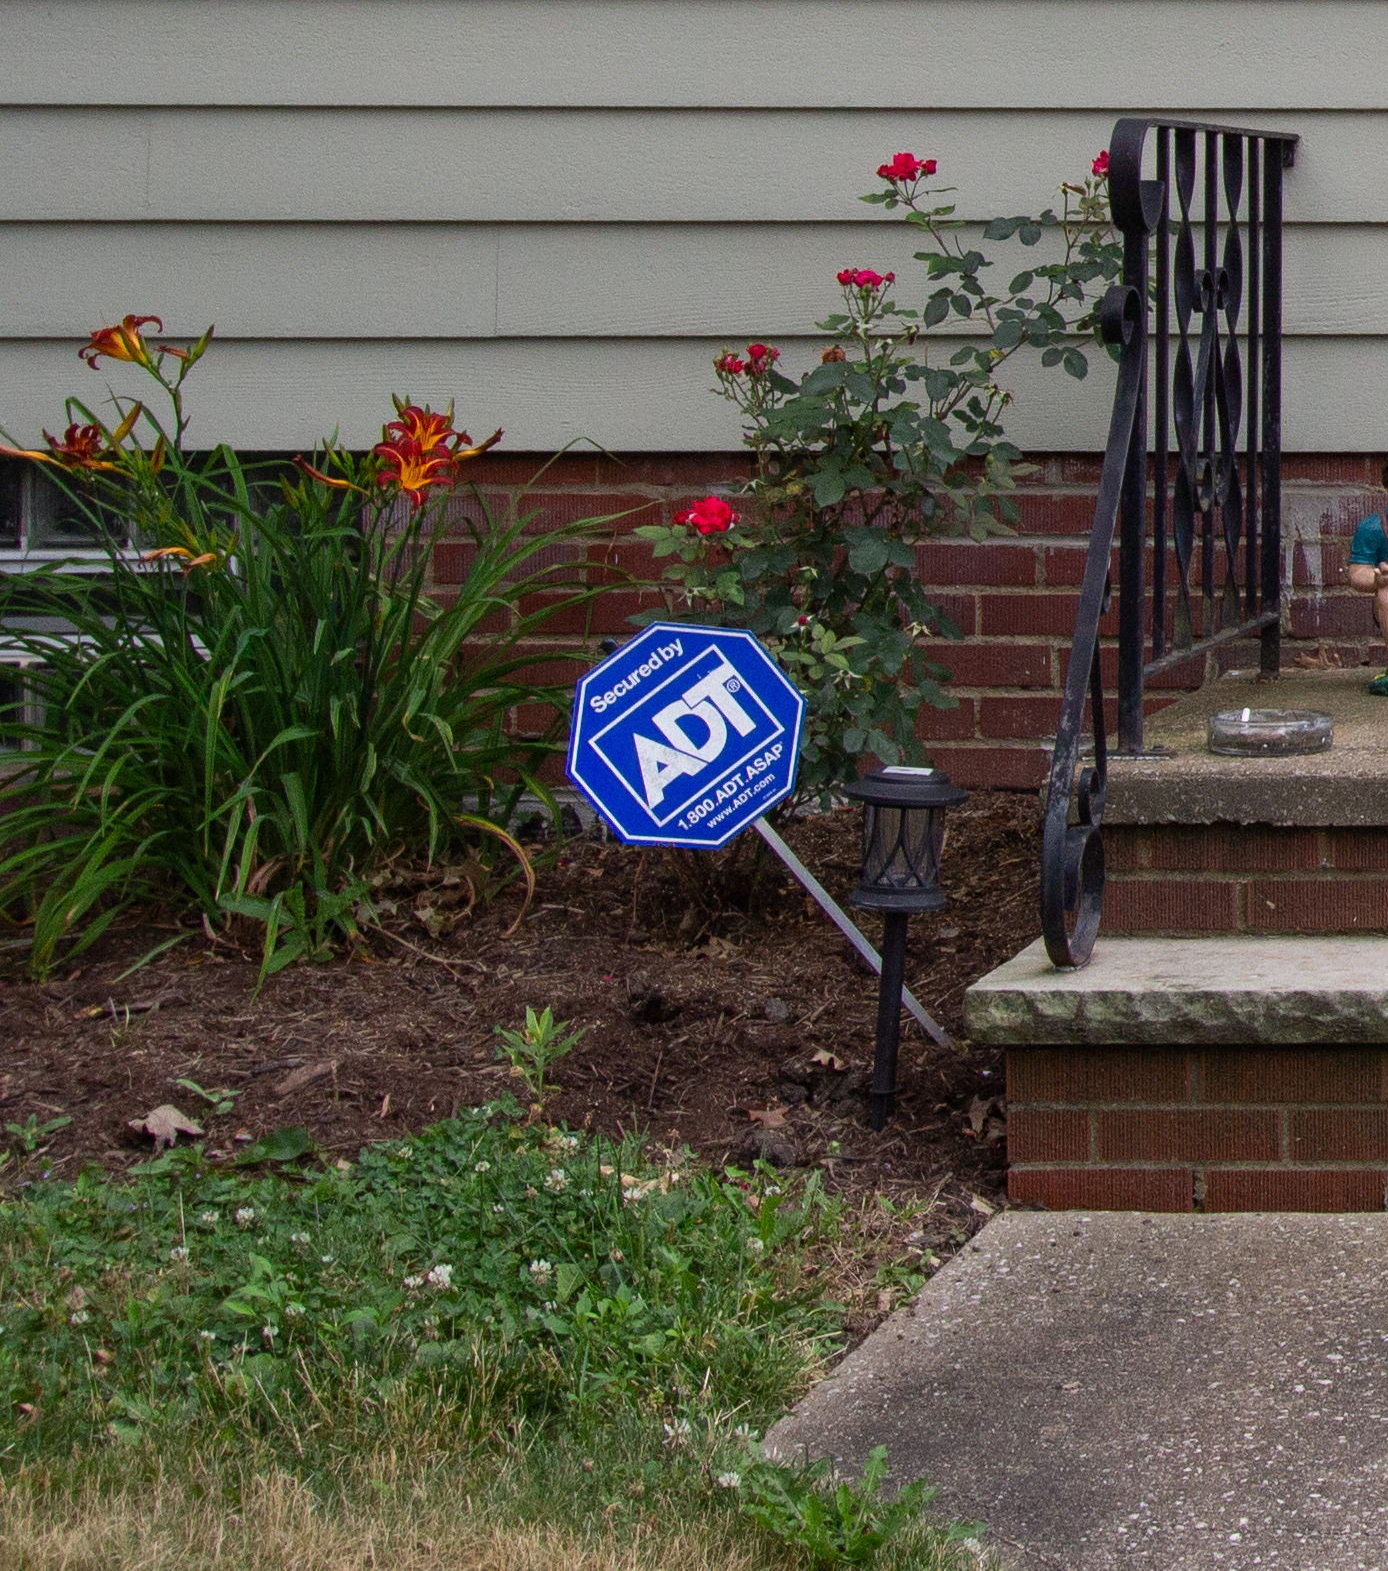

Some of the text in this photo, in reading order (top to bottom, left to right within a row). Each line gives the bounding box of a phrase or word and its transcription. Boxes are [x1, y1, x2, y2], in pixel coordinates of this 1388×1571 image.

[590, 638, 684, 713] Secured by
[632, 663, 756, 809] ADT
[677, 743, 783, 830] 1.800.ADT.ASAP
[706, 773, 776, 828] www.ADT.com
